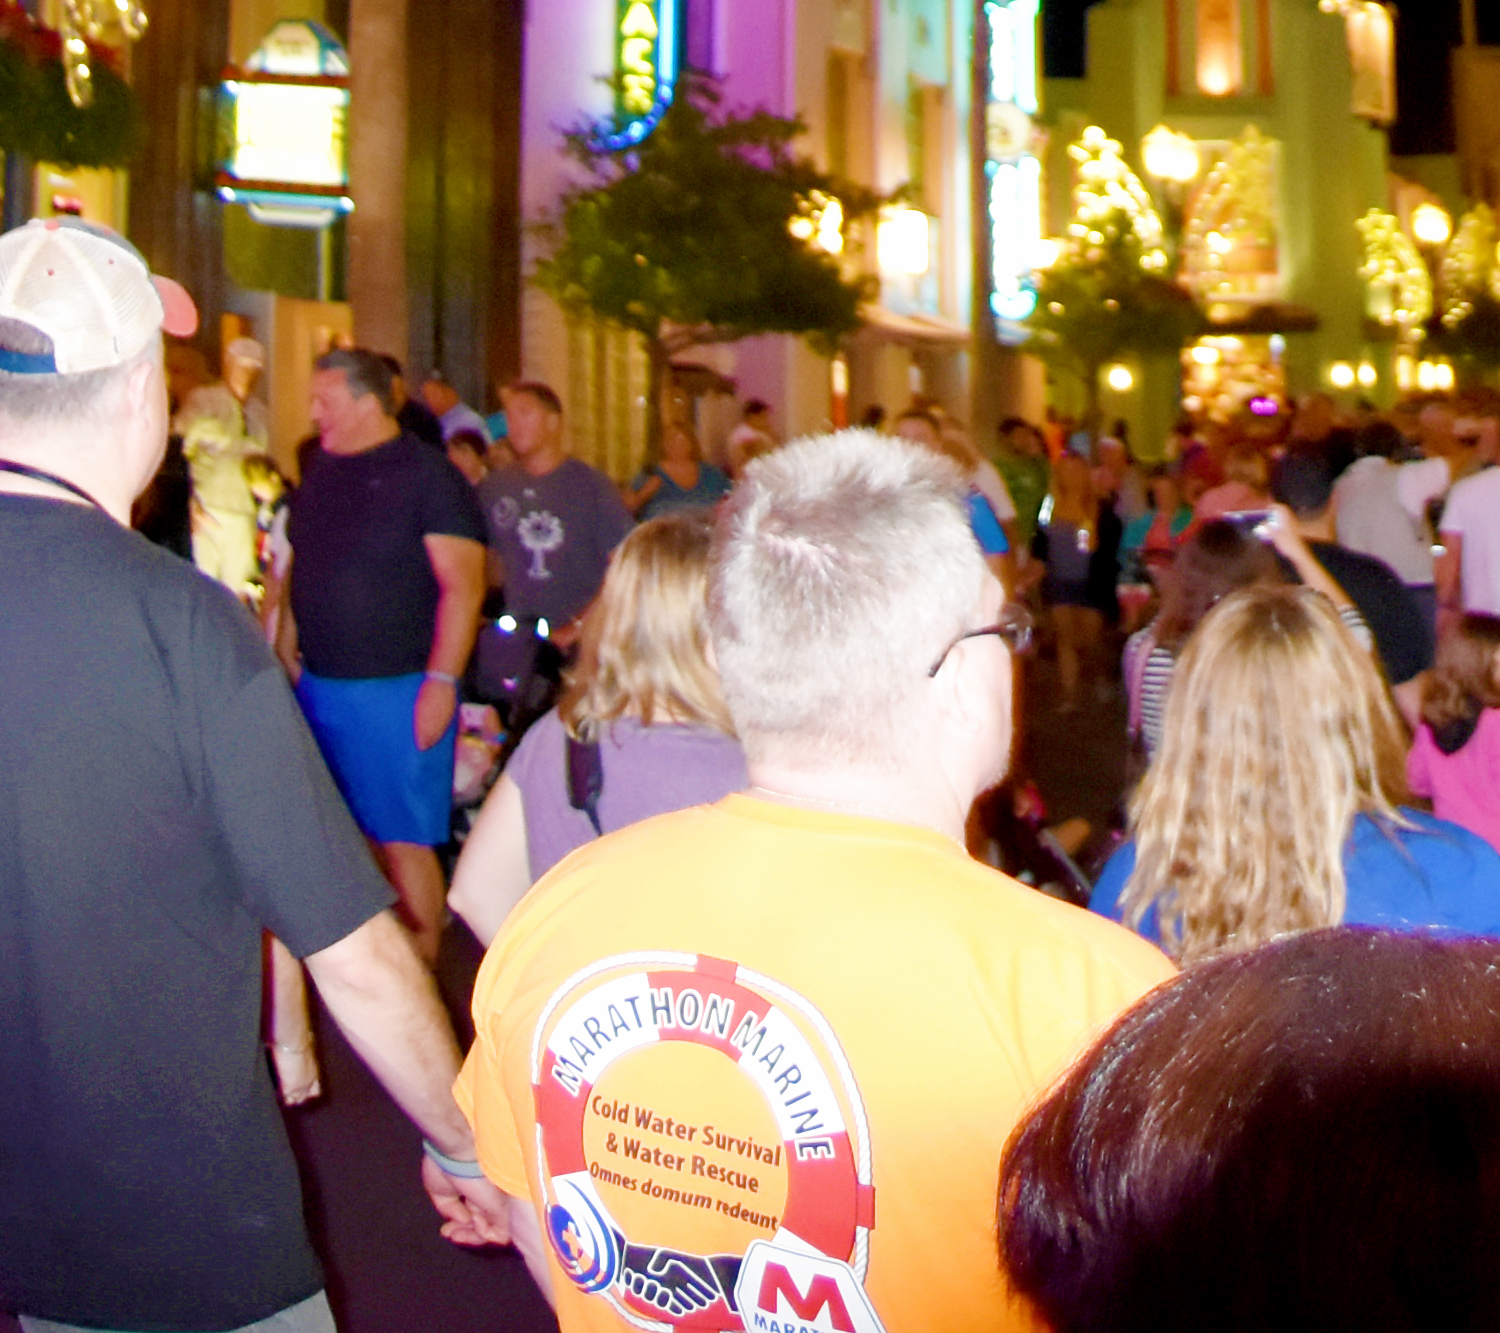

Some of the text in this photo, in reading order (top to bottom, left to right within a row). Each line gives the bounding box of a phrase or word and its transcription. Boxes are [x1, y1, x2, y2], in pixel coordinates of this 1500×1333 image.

[553, 988, 834, 1160] MARATHON MARINE
[591, 1094, 782, 1167] Cold Water Survival
[605, 1132, 760, 1194] & Water Rescue
[589, 1161, 779, 1232] Omnes domum redeunt
